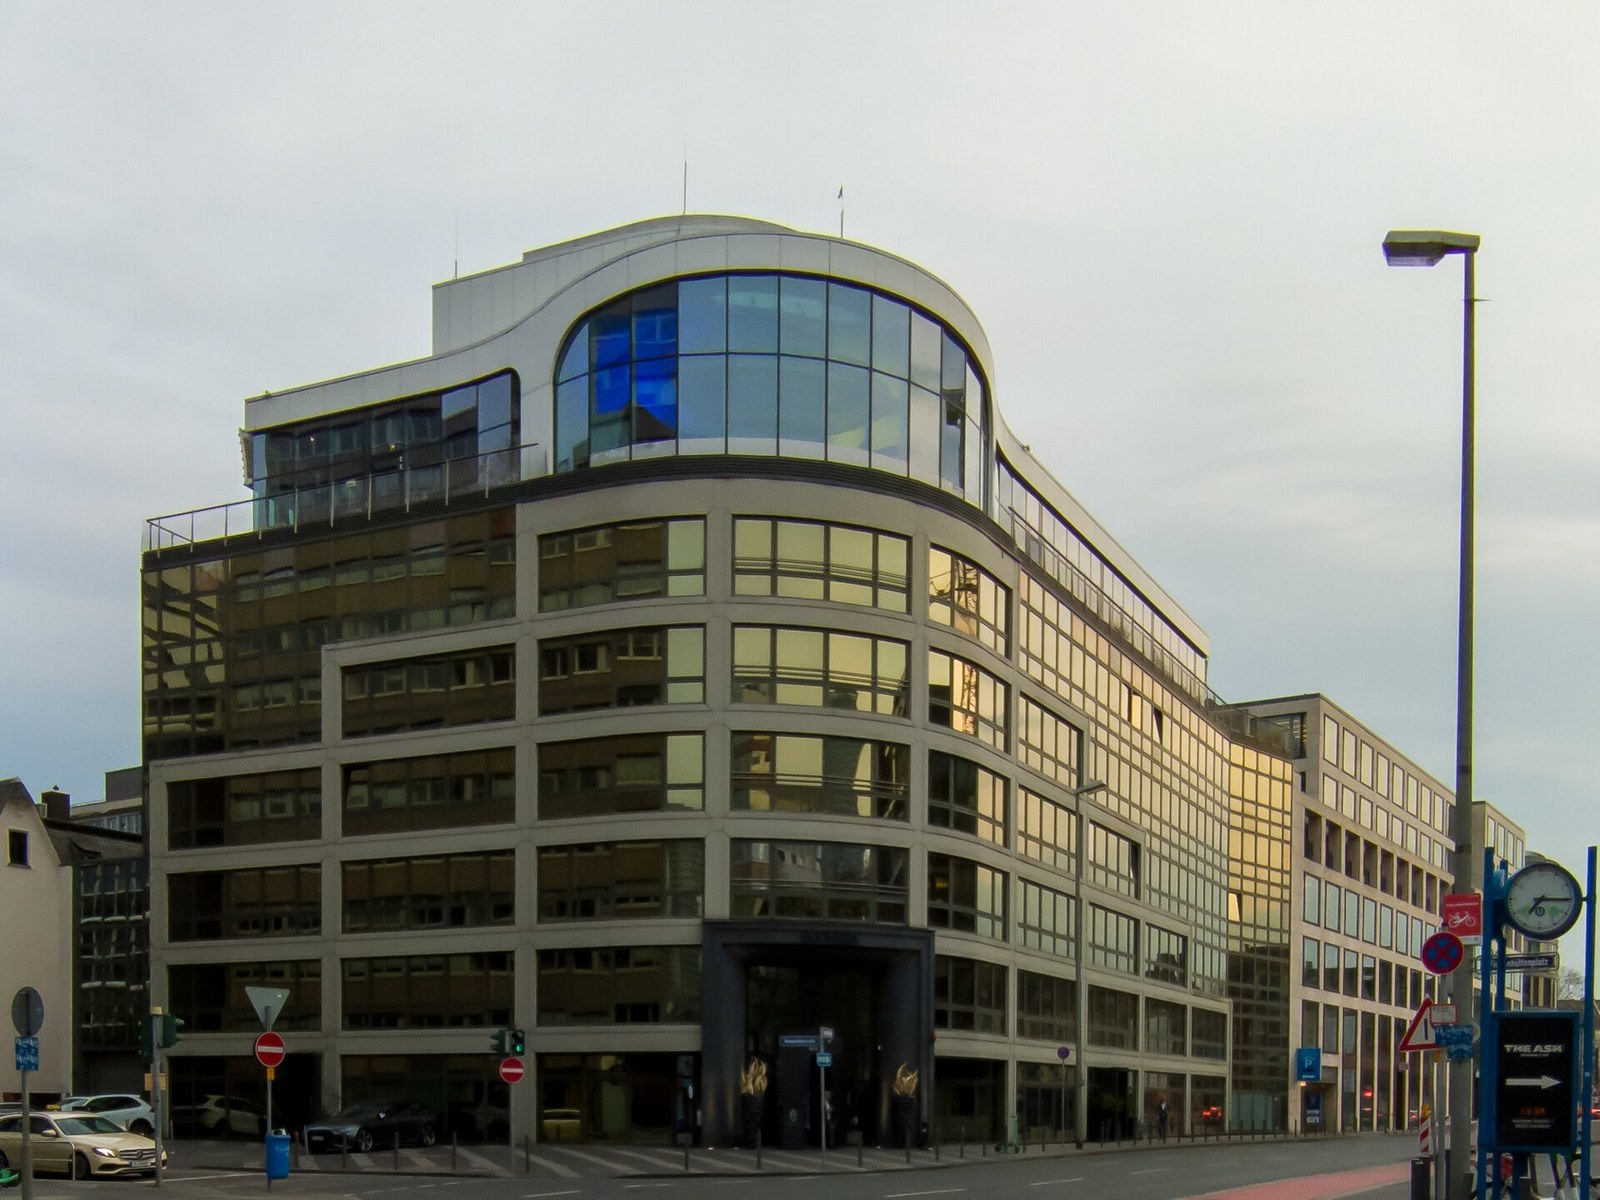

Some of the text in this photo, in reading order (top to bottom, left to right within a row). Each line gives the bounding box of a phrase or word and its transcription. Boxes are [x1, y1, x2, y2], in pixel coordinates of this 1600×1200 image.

[1503, 1044, 1563, 1053] THE ASH
[1304, 1059, 1313, 1069] P
